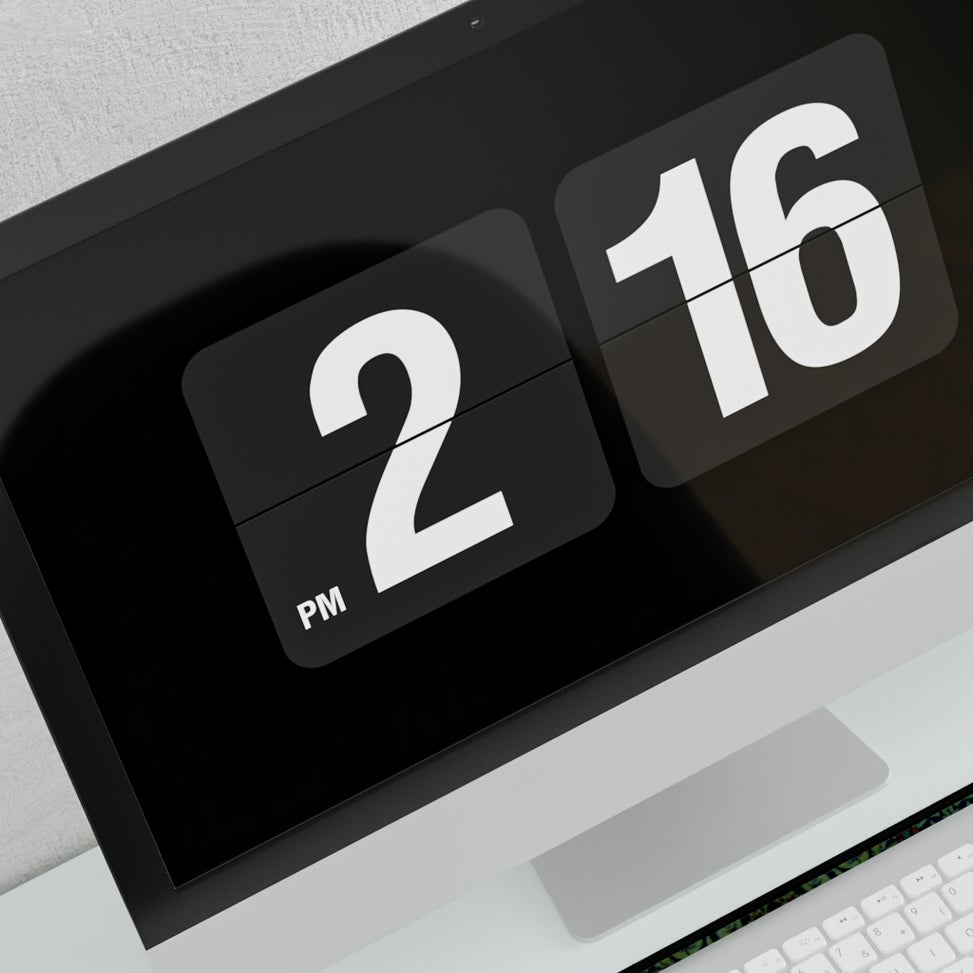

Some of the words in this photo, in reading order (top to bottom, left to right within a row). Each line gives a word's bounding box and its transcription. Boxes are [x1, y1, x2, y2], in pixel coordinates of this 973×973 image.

[310, 309, 513, 596] 2
[606, 103, 900, 418] 16
[297, 586, 346, 630] PM
[948, 887, 957, 896] 0
[910, 907, 918, 916] 9
[873, 928, 882, 936] 8
[835, 947, 842, 957] 7
